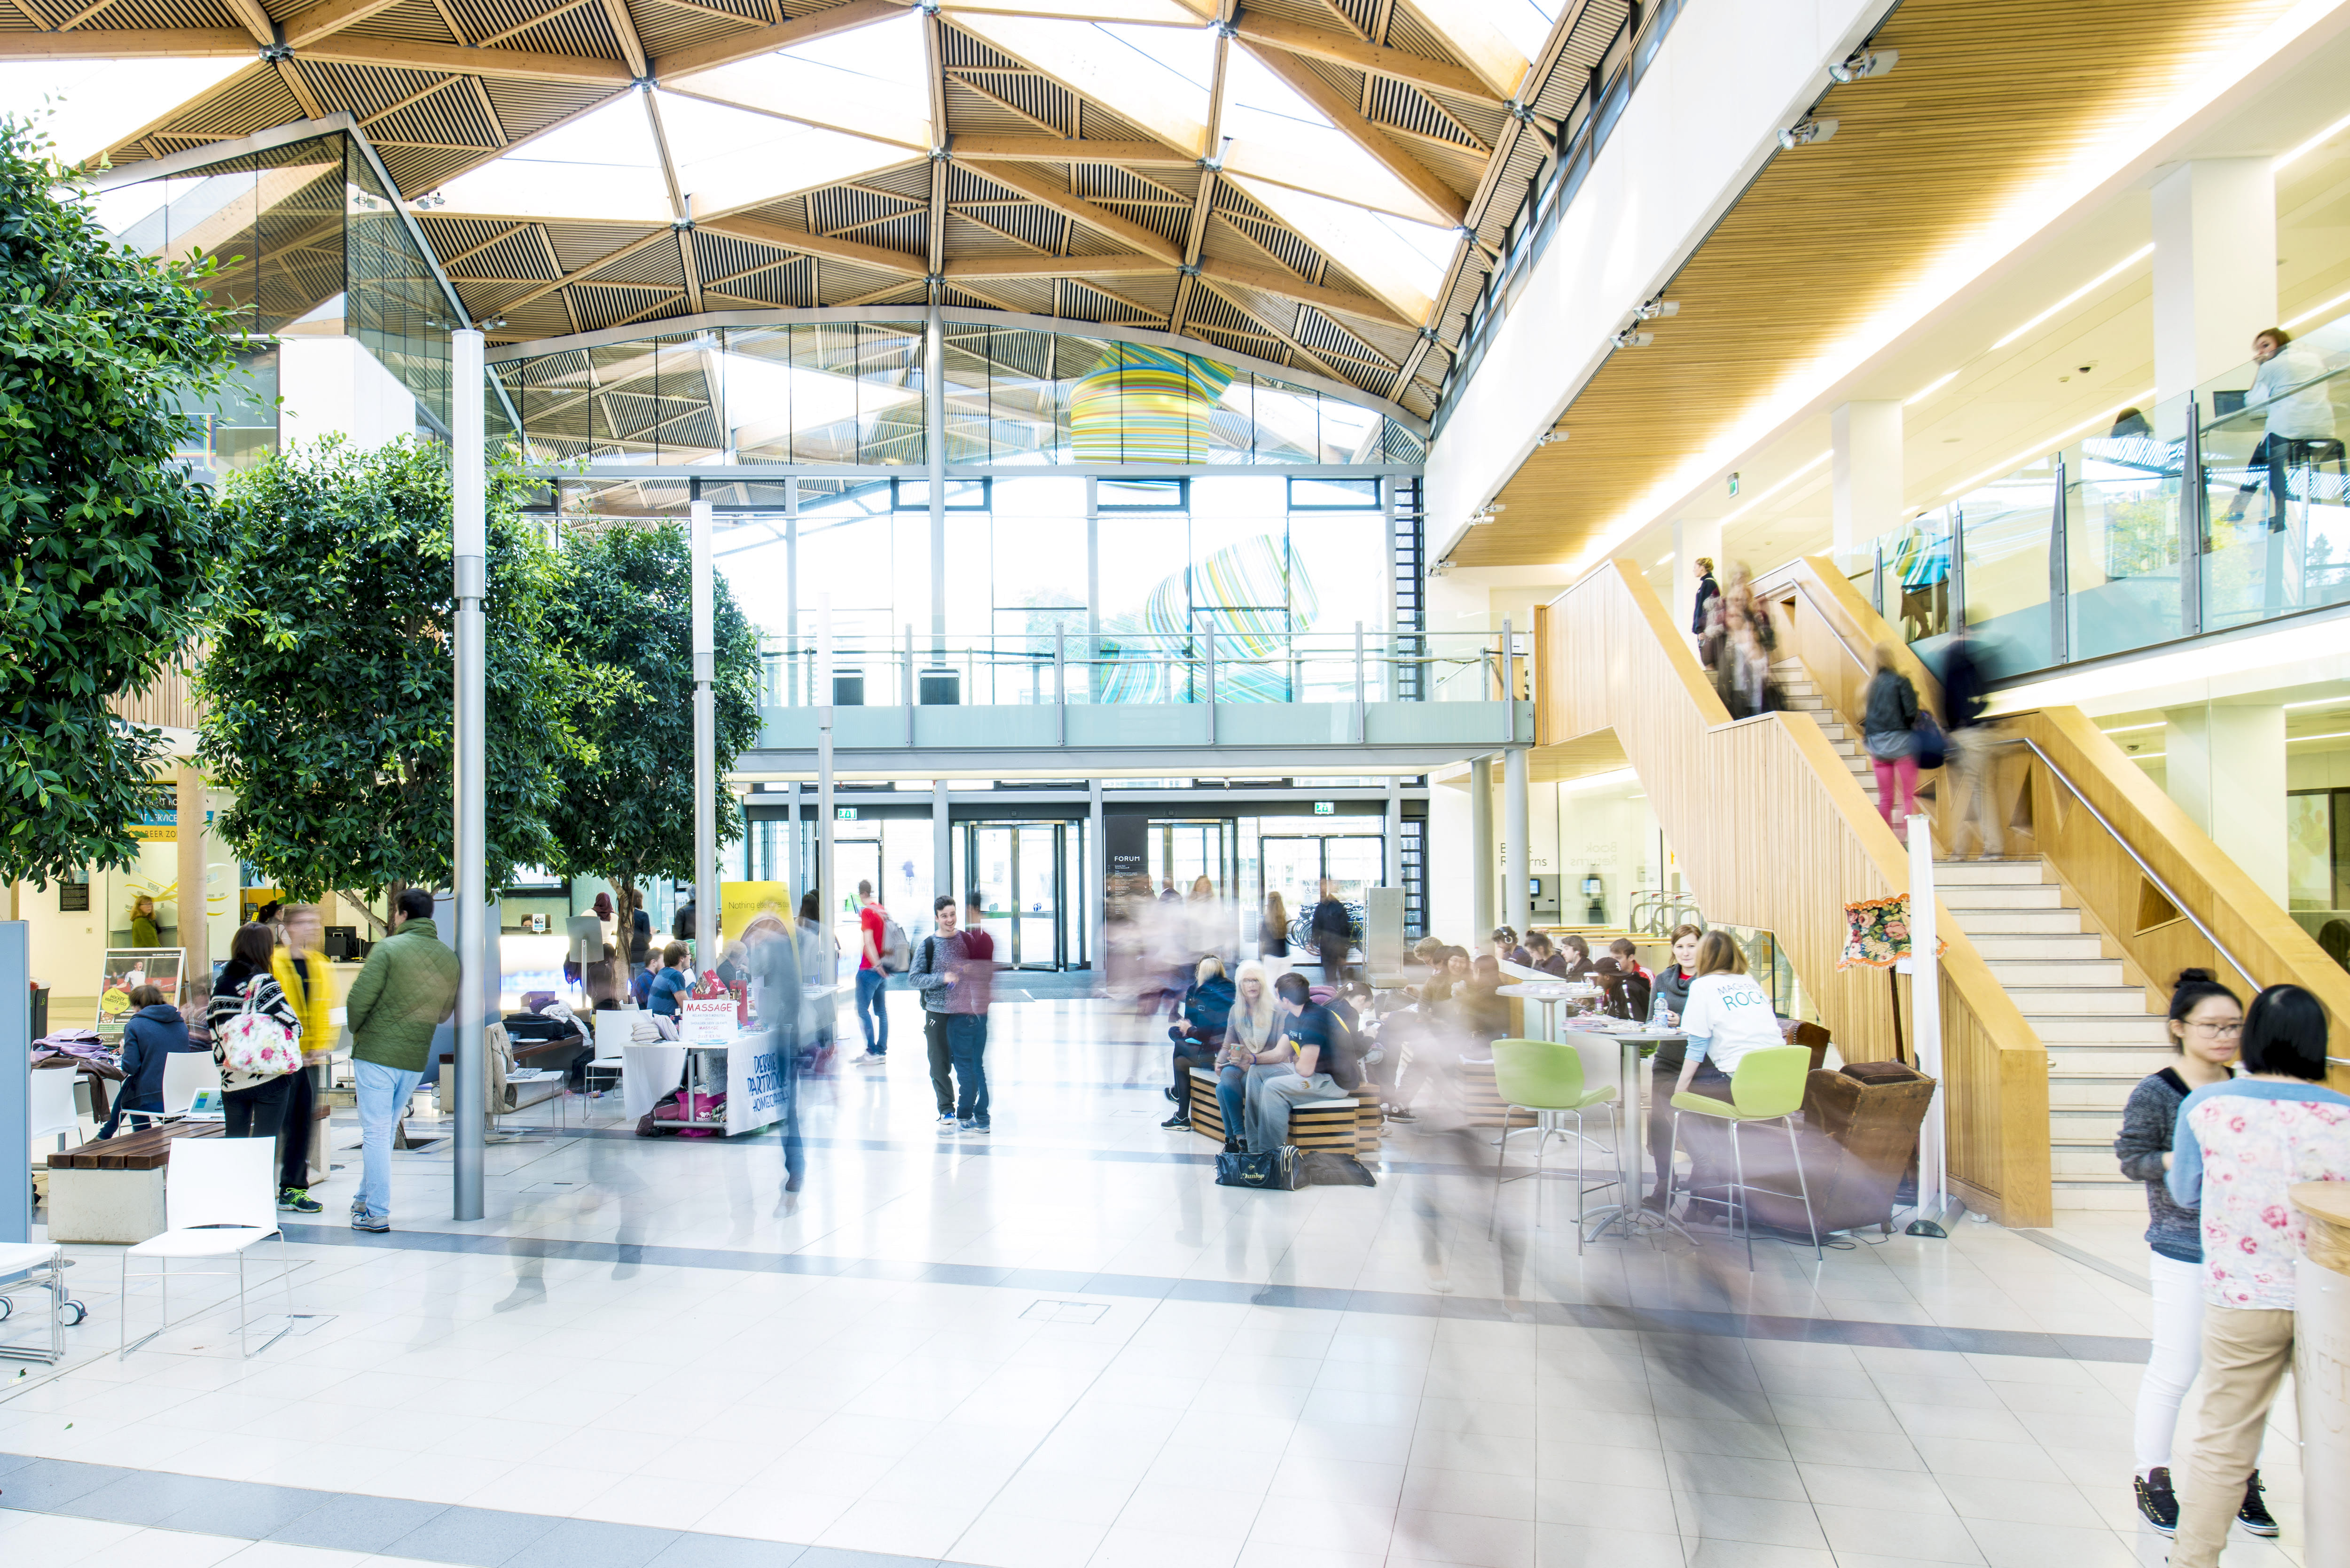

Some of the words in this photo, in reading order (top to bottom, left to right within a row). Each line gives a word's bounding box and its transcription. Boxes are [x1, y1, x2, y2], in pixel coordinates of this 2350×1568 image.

[1501, 856, 1547, 866] Rrns
[728, 901, 755, 910] Nothing
[1723, 991, 1768, 1011] ROCK
[686, 1003, 732, 1012] MASSAGE
[753, 1053, 776, 1074] DEBBIE
